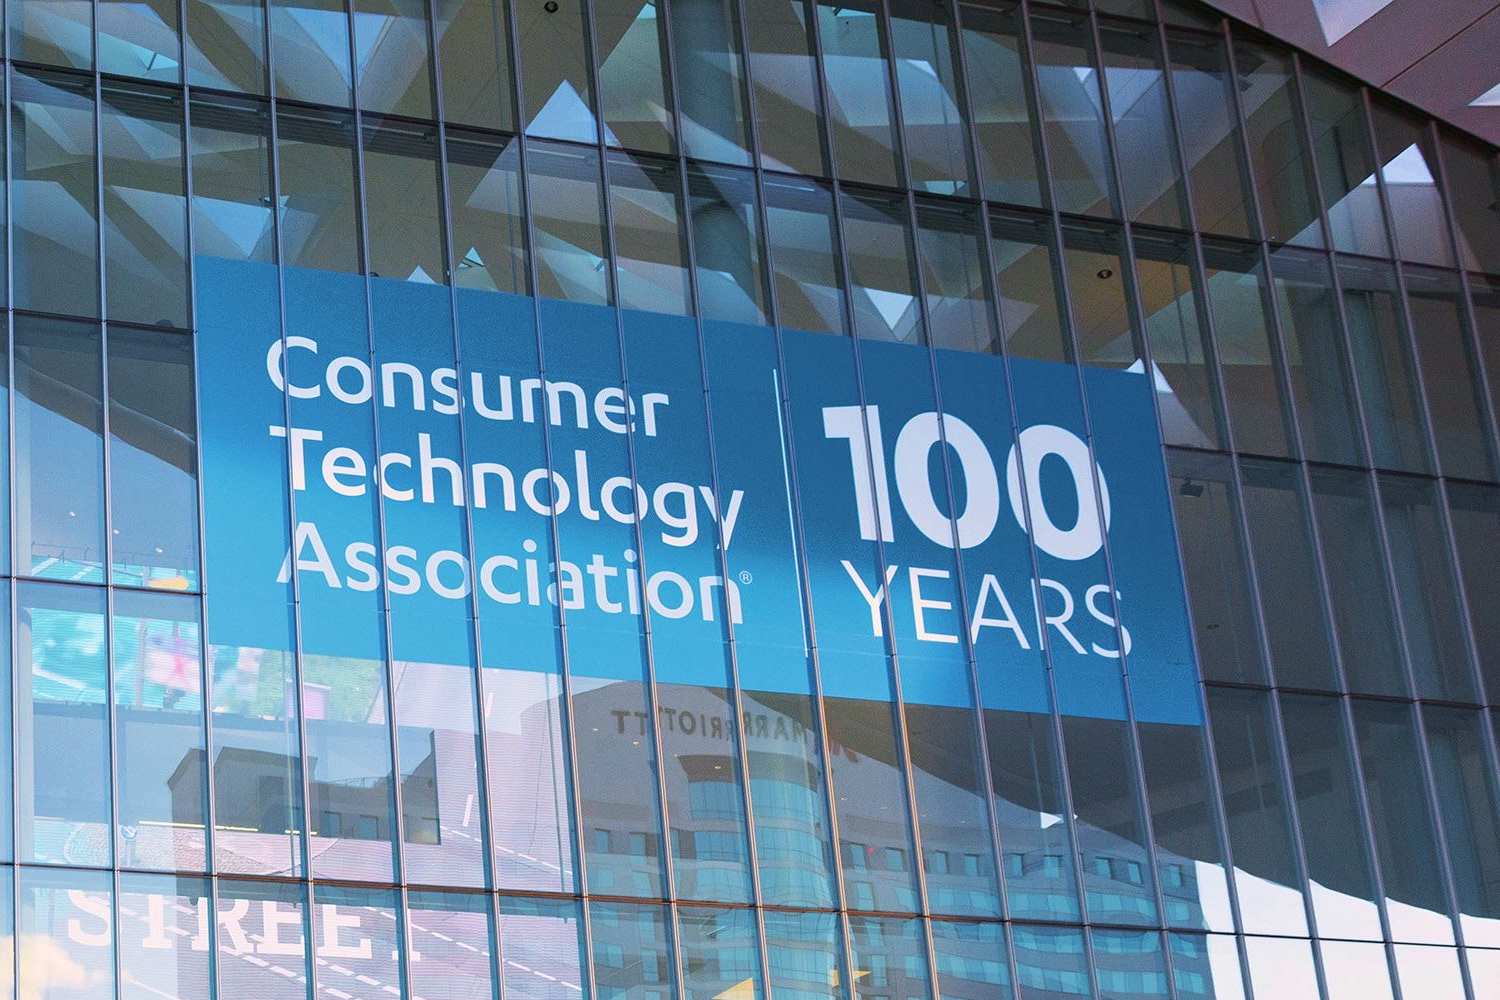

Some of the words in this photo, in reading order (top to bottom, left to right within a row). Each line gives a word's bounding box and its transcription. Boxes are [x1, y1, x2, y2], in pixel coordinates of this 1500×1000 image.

[267, 336, 669, 437] Consumer
[269, 424, 744, 551] Technology
[822, 405, 1111, 561] 100
[840, 559, 1132, 658] YEARS
